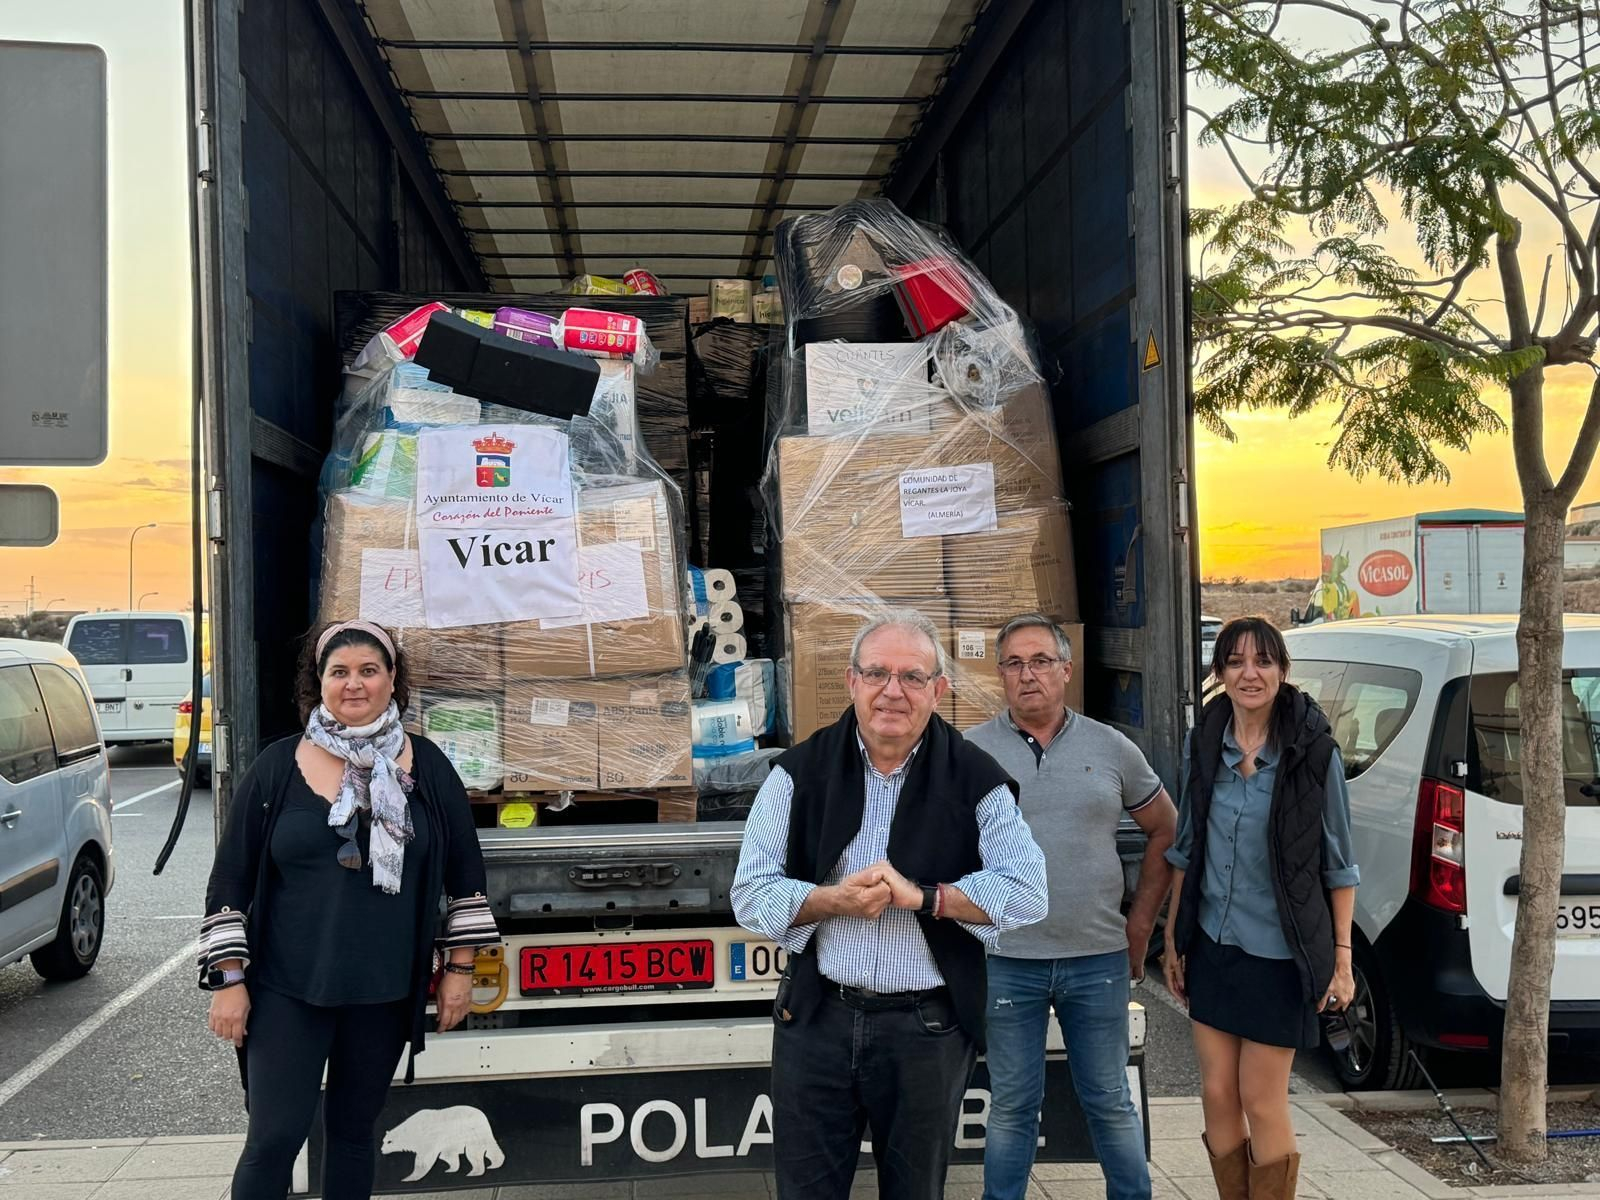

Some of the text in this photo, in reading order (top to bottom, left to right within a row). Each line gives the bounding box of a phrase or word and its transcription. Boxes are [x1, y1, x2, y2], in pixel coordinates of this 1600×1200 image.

[903, 474, 958, 485] COMUNIDAD DE
[903, 487, 939, 495] REGANTES
[950, 486, 967, 494] JOYA
[424, 493, 564, 506] Ayuntamiento de Vícar
[433, 506, 553, 523] Corazón del Poniente
[928, 510, 964, 519] (ALMERÍA)
[446, 534, 555, 569] Vícar
[975, 650, 984, 658] 42
[105, 703, 119, 712] BNT
[717, 717, 725, 739] doble
[510, 772, 529, 783] 80
[606, 772, 625, 783] 80
[531, 945, 706, 984] R 1415 BCW
[753, 945, 790, 976] 00
[582, 983, 655, 993] www.cargobull.com
[580, 1093, 773, 1167] POLA
